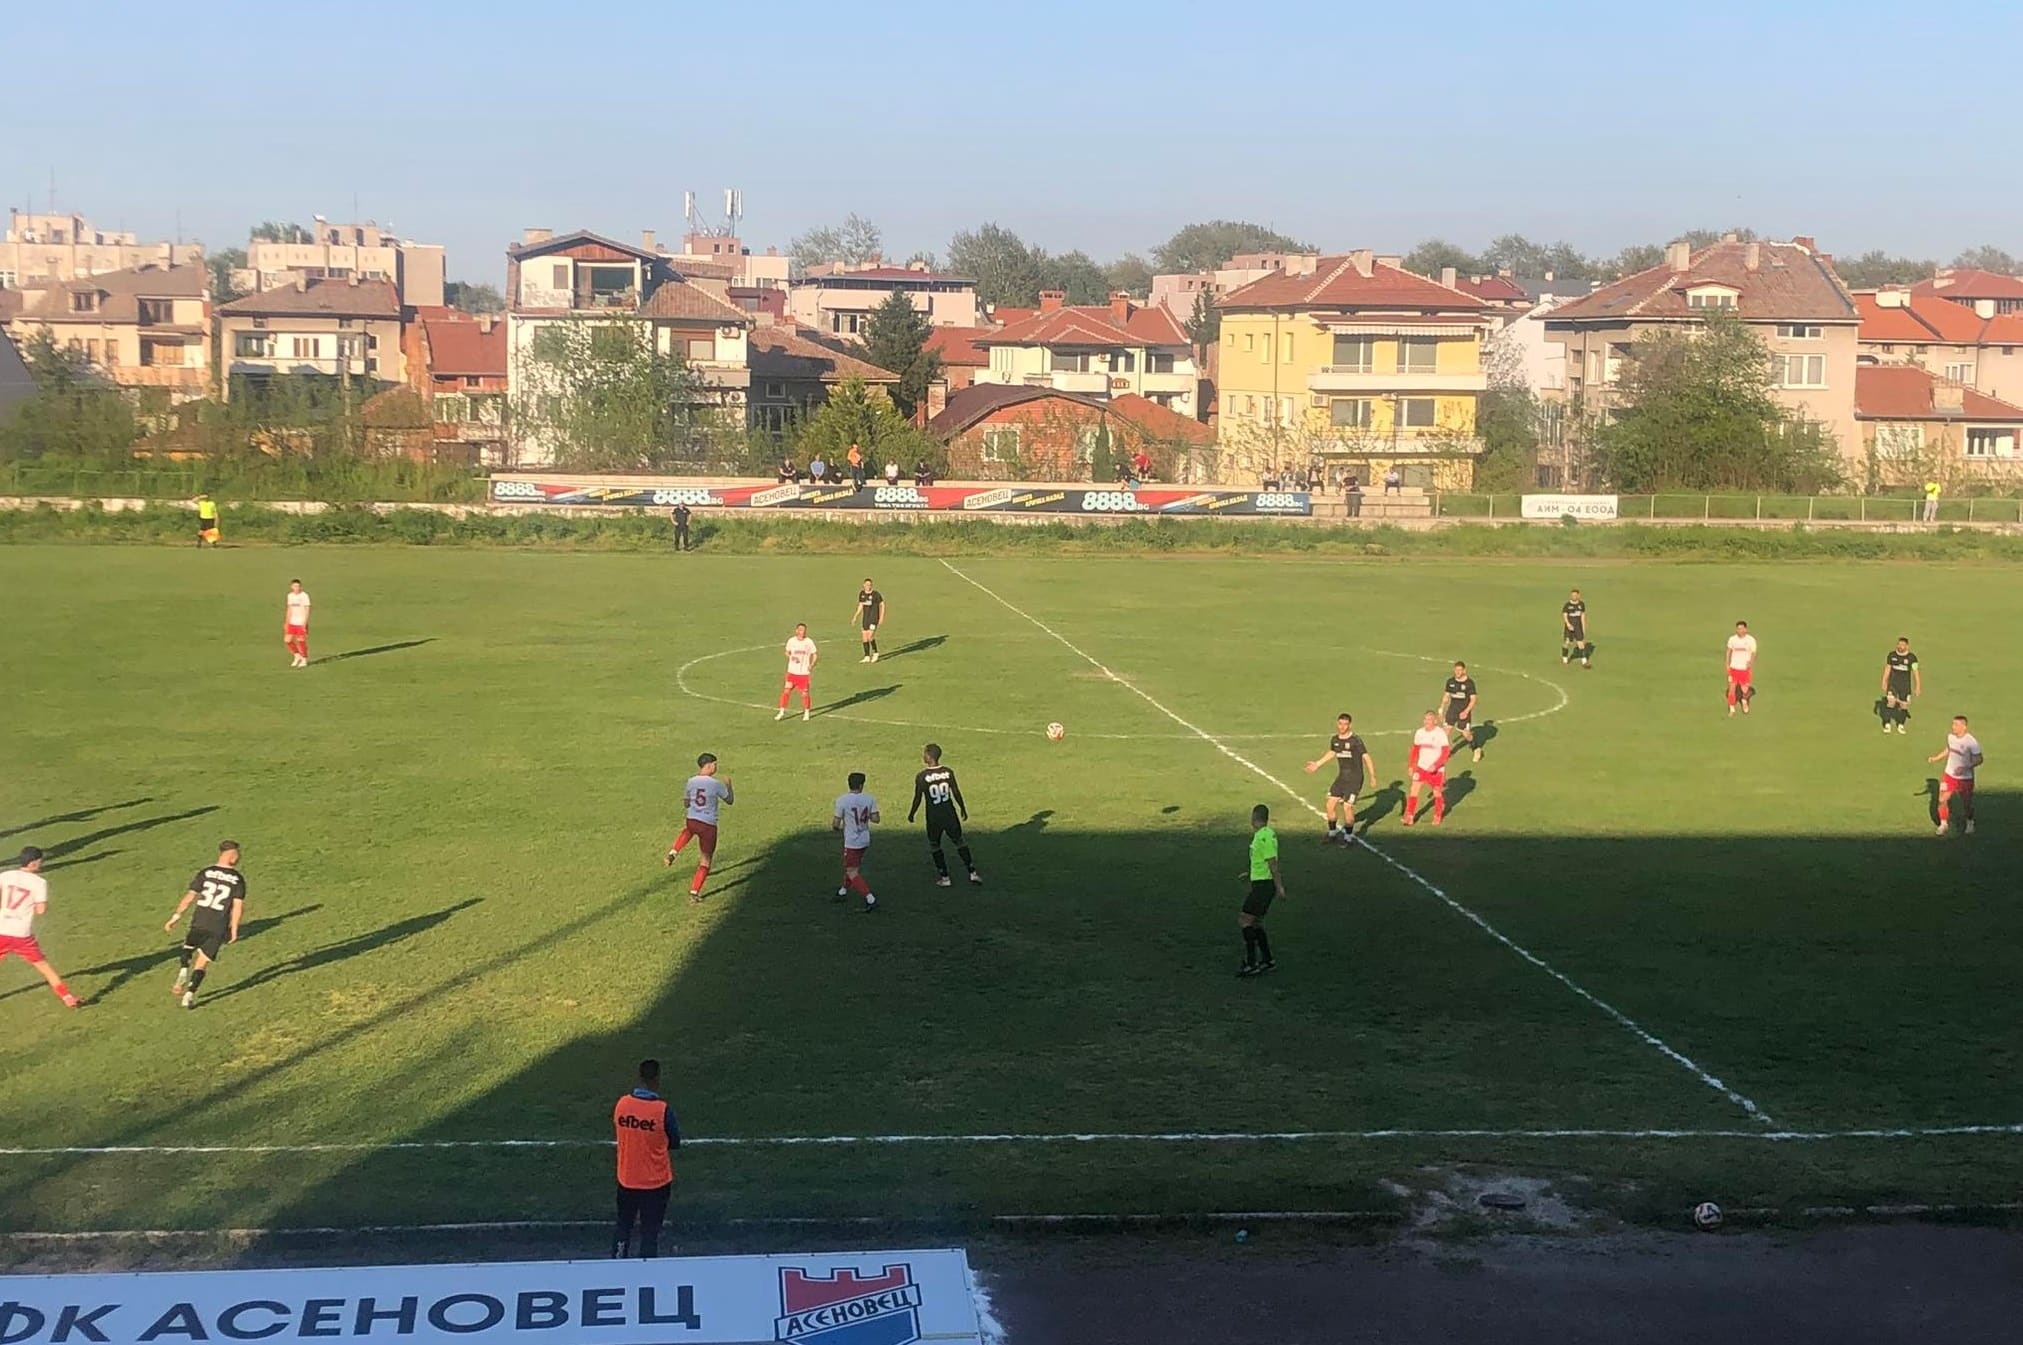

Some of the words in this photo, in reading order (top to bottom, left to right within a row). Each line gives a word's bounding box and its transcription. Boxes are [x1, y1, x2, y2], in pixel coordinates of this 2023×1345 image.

[695, 788, 706, 807] 5
[929, 782, 949, 804] 99
[851, 805, 870, 825] 14
[6, 884, 31, 910] 17
[197, 881, 231, 911] 32
[618, 1115, 656, 1132] efbet
[136, 1285, 701, 1342] АСЕНОВЕЦ
[786, 1290, 913, 1336] АСЕНОВЕЦ
